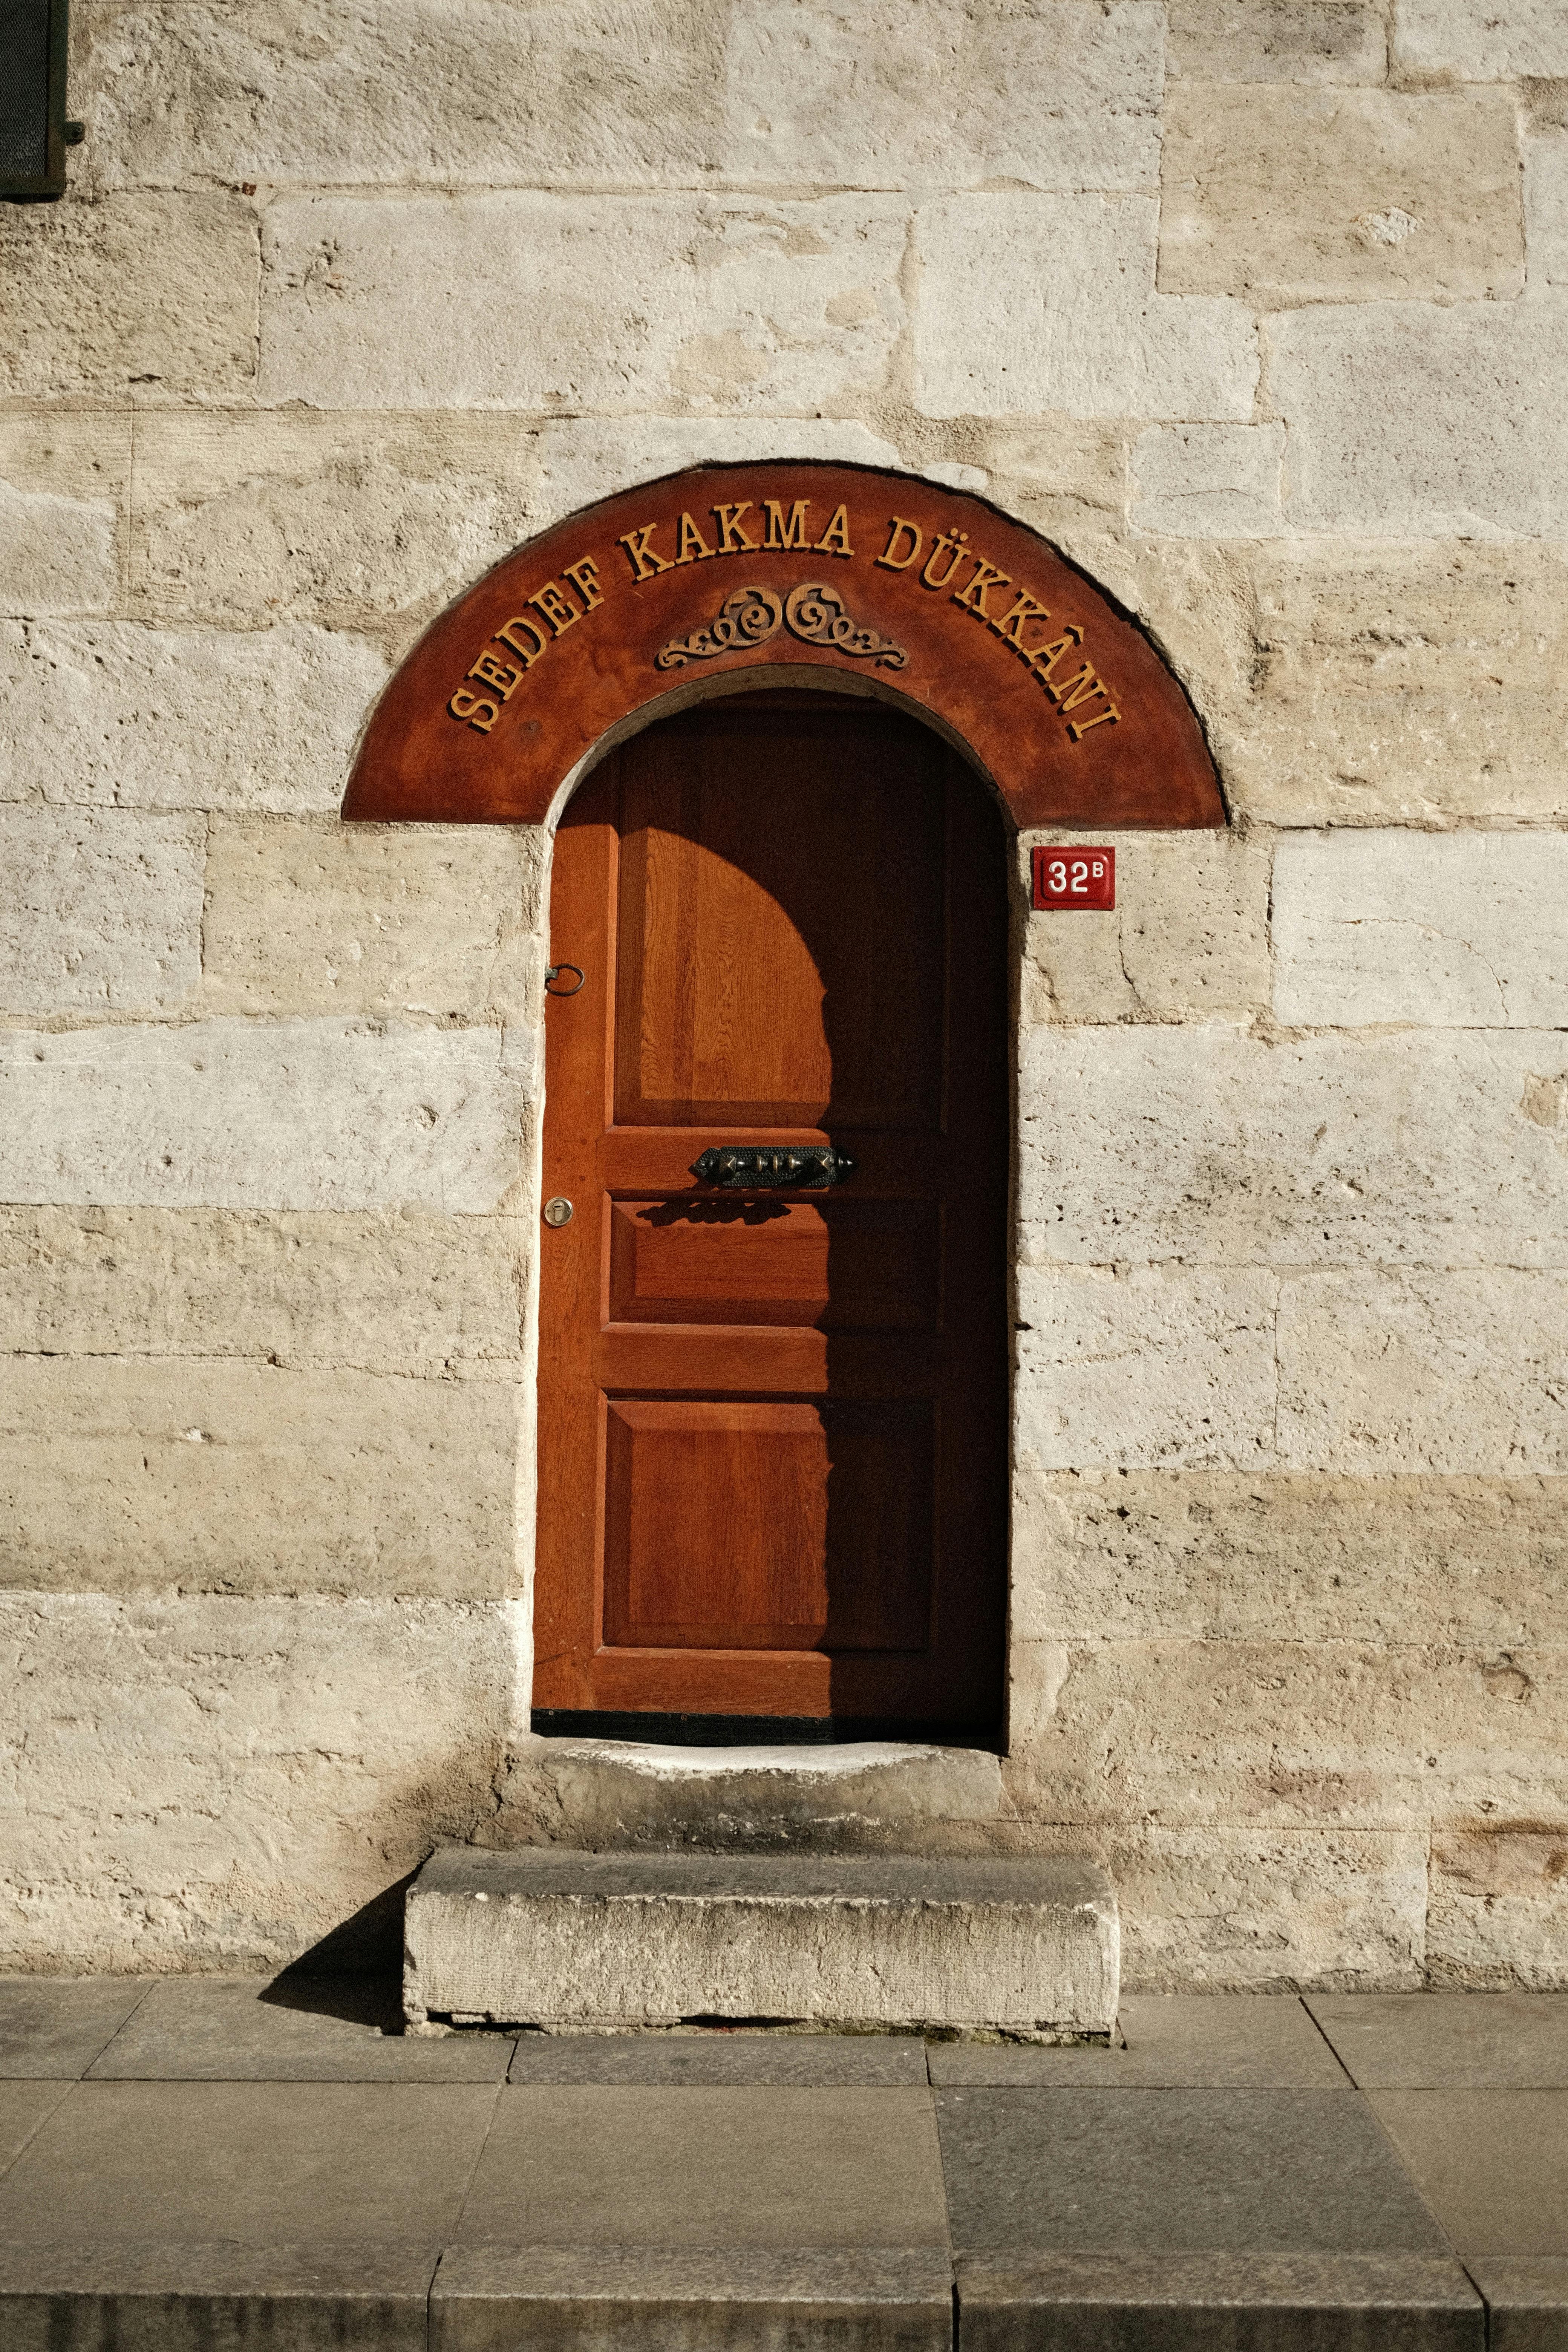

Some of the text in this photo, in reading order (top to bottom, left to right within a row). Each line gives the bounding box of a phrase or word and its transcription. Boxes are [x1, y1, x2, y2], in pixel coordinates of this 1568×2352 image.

[451, 500, 1122, 739] SEDEF KAKMA DÜKKÂNI
